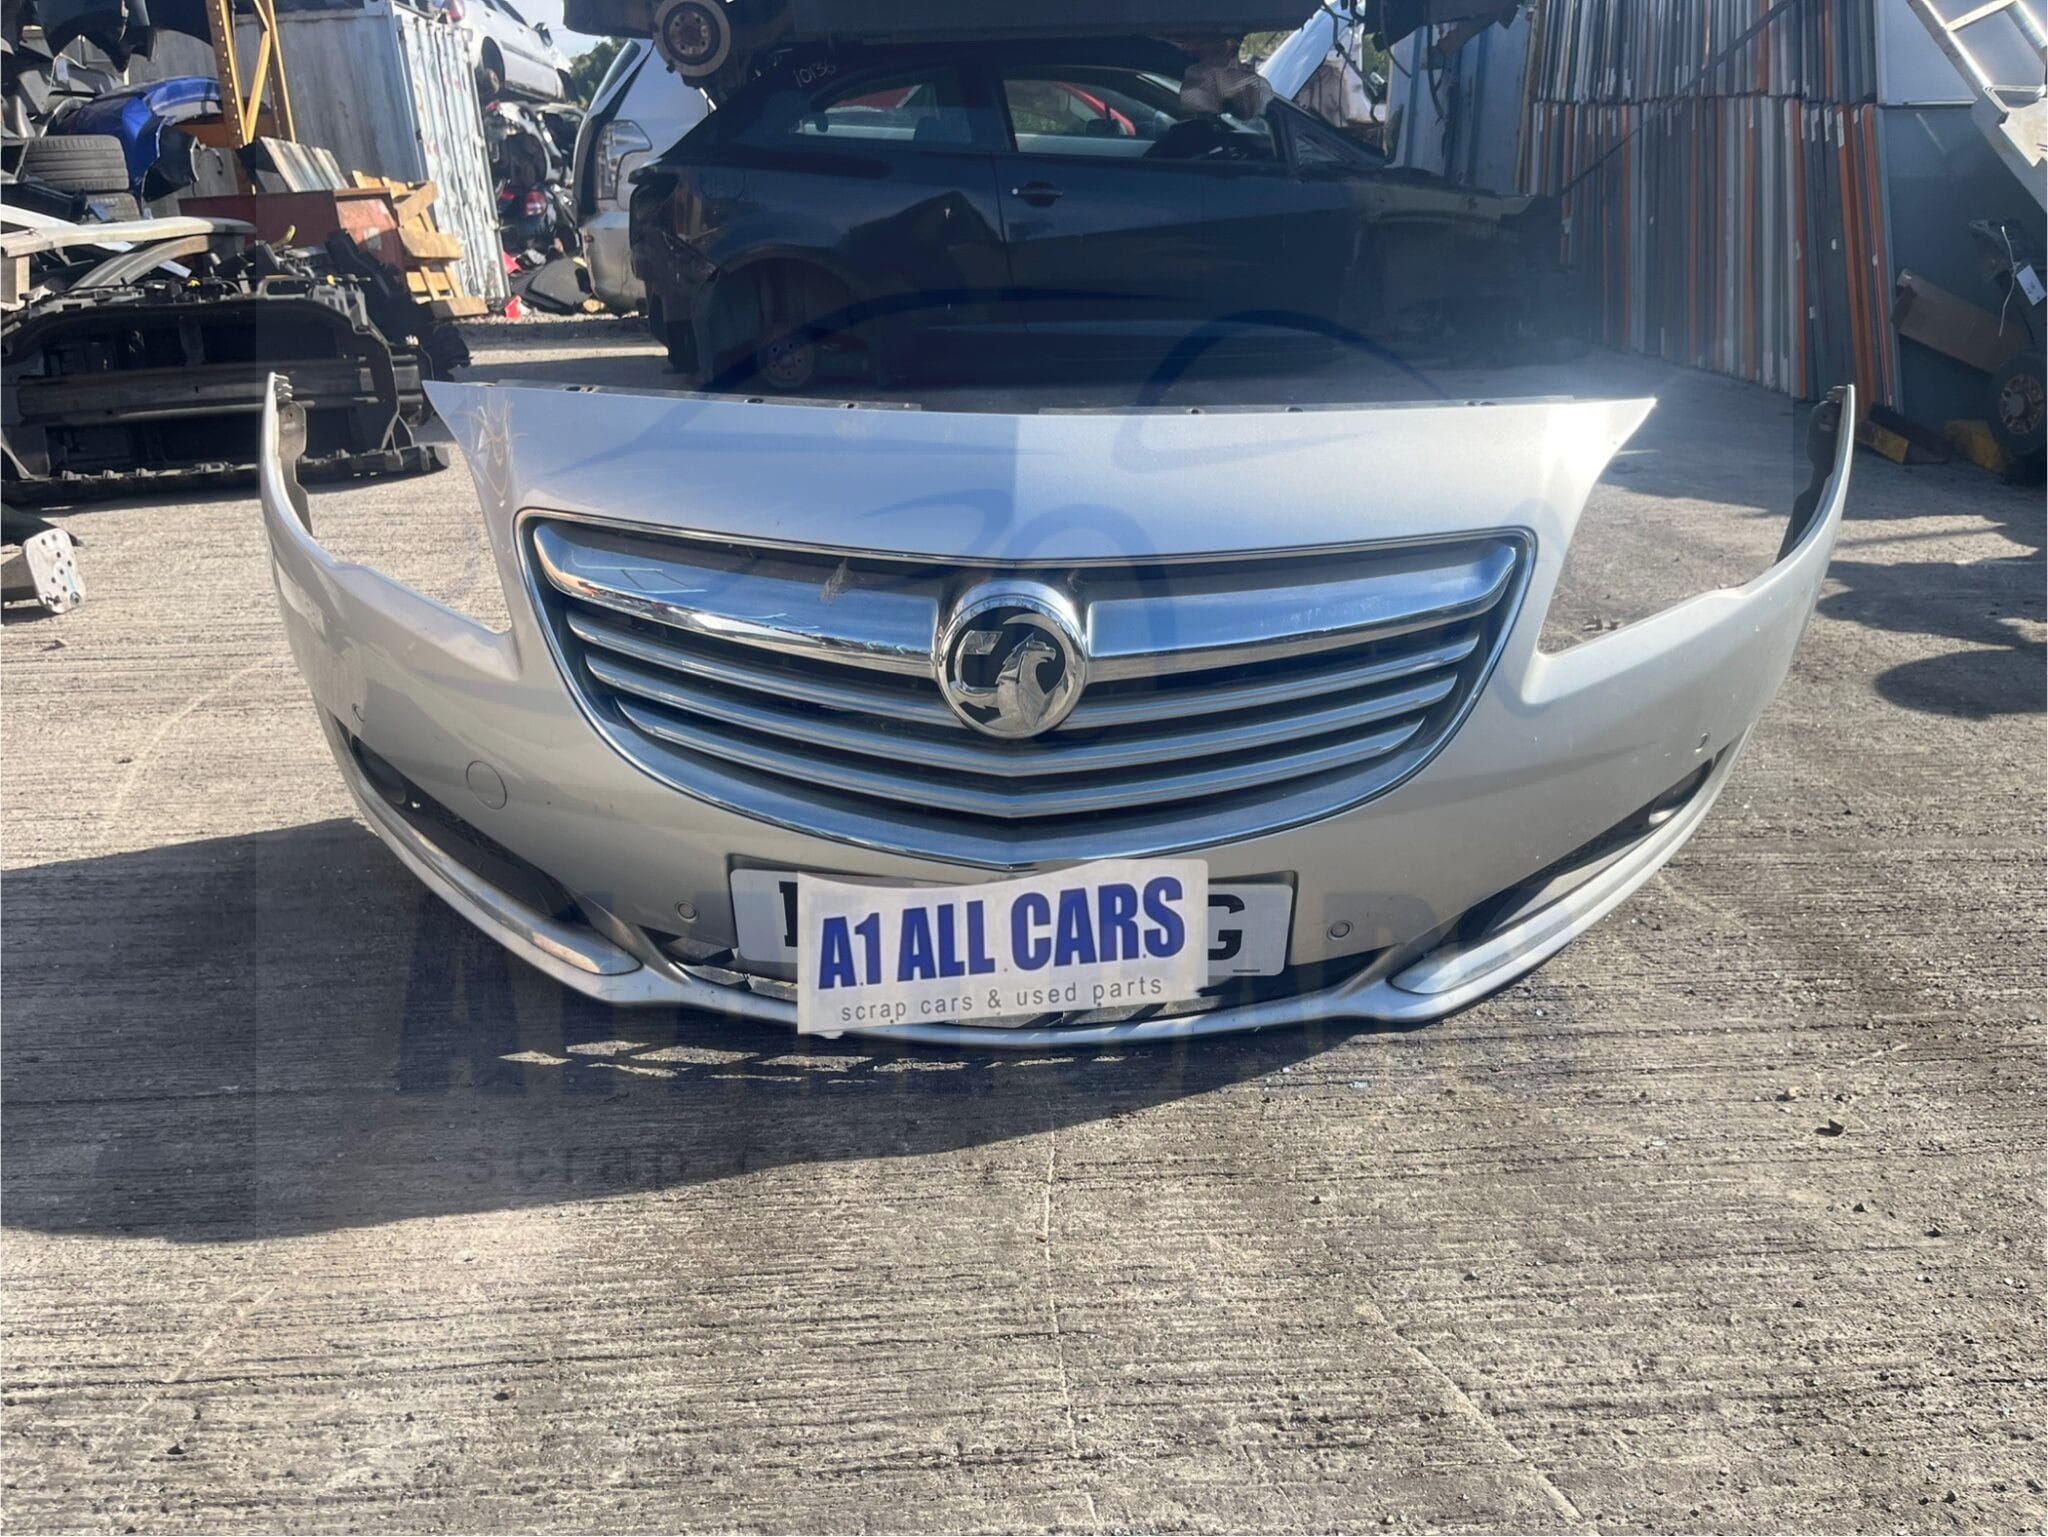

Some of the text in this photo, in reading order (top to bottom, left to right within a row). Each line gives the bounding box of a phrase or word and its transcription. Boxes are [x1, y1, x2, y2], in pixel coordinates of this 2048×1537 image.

[897, 899, 996, 982] ALL
[1011, 876, 1185, 971] CARS
[841, 976, 1163, 1021] scrap cars & used parts
